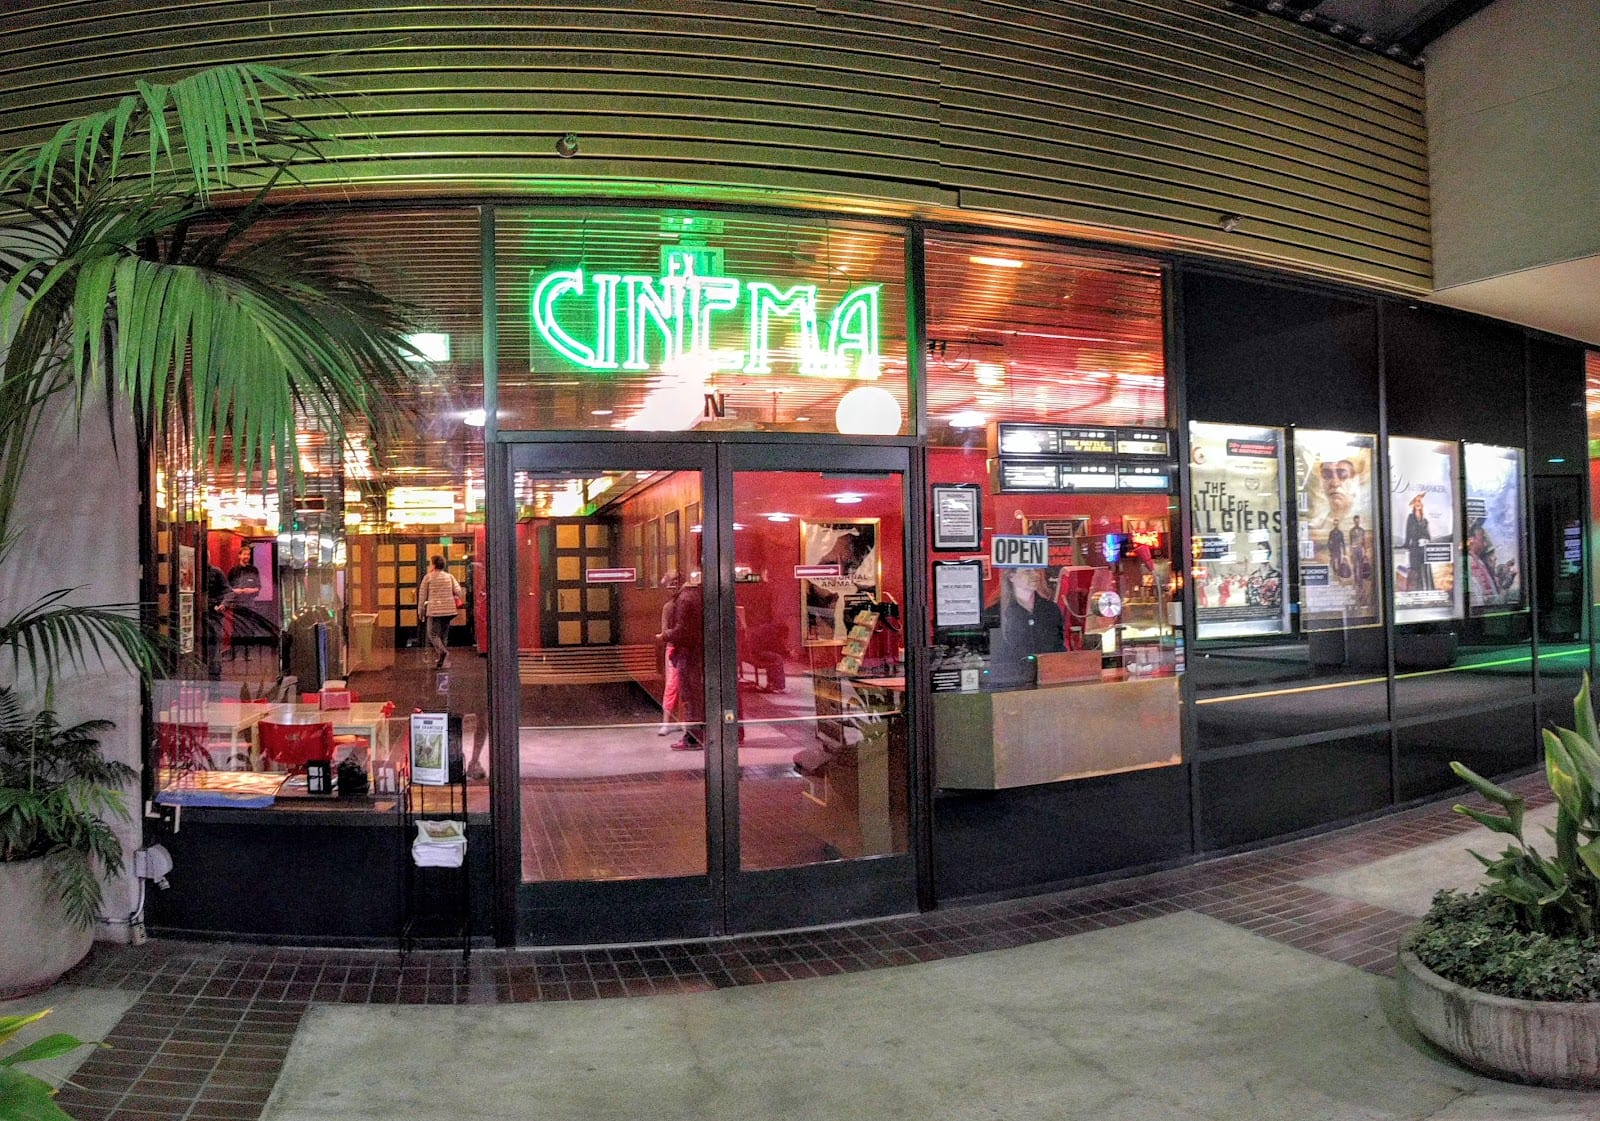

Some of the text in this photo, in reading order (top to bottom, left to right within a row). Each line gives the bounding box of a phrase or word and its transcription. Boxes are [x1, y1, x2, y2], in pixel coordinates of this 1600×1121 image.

[532, 268, 883, 378] CINEMA
[1204, 482, 1227, 495] THE
[1238, 500, 1249, 512] OF
[995, 538, 1043, 564] OPEN
